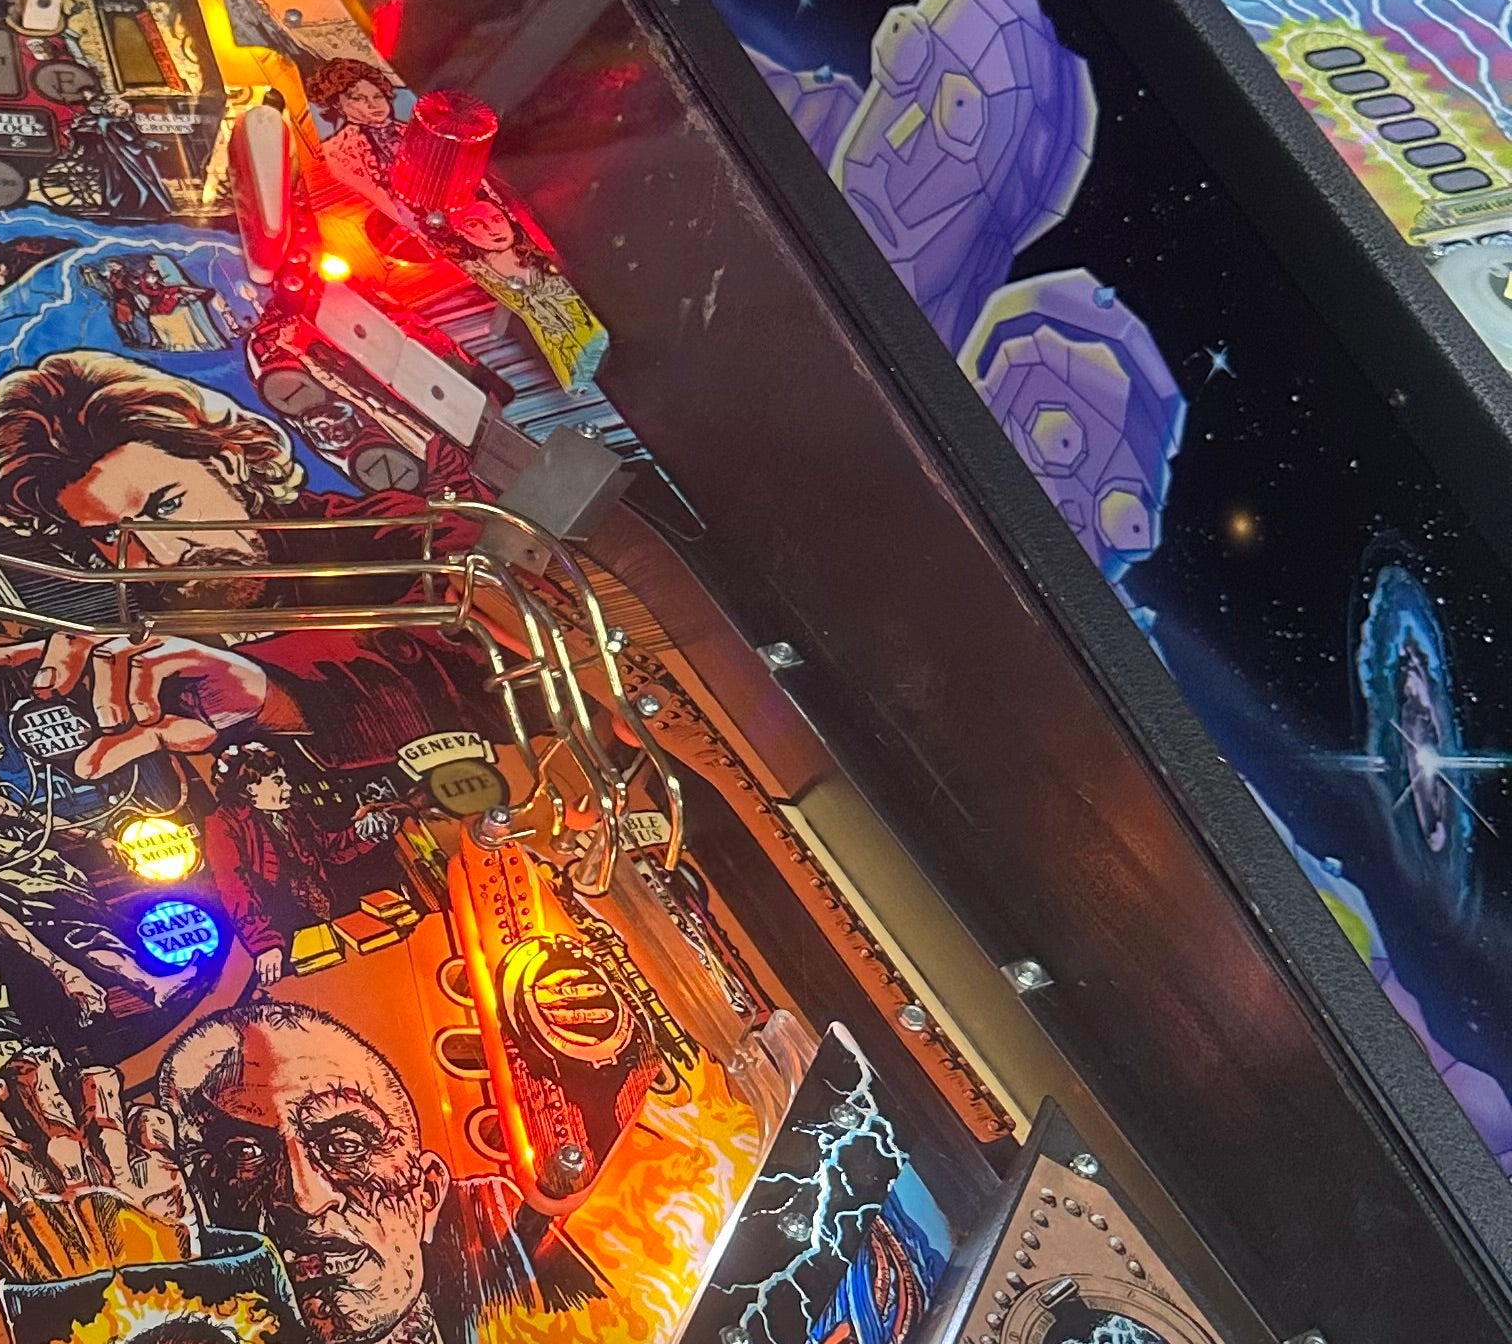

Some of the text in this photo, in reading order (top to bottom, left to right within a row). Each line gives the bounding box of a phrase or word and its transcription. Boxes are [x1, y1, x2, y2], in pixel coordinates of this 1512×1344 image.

[51, 69, 88, 92] E
[26, 706, 72, 728] LITE
[22, 718, 90, 743] EXTRA
[35, 735, 85, 757] BALL
[404, 733, 482, 760] GENEVA
[441, 774, 494, 799] LITE
[121, 824, 200, 855] VOLTAGE
[140, 843, 191, 864] MODE
[139, 908, 206, 938] GRAVE
[157, 928, 212, 954] YARD
